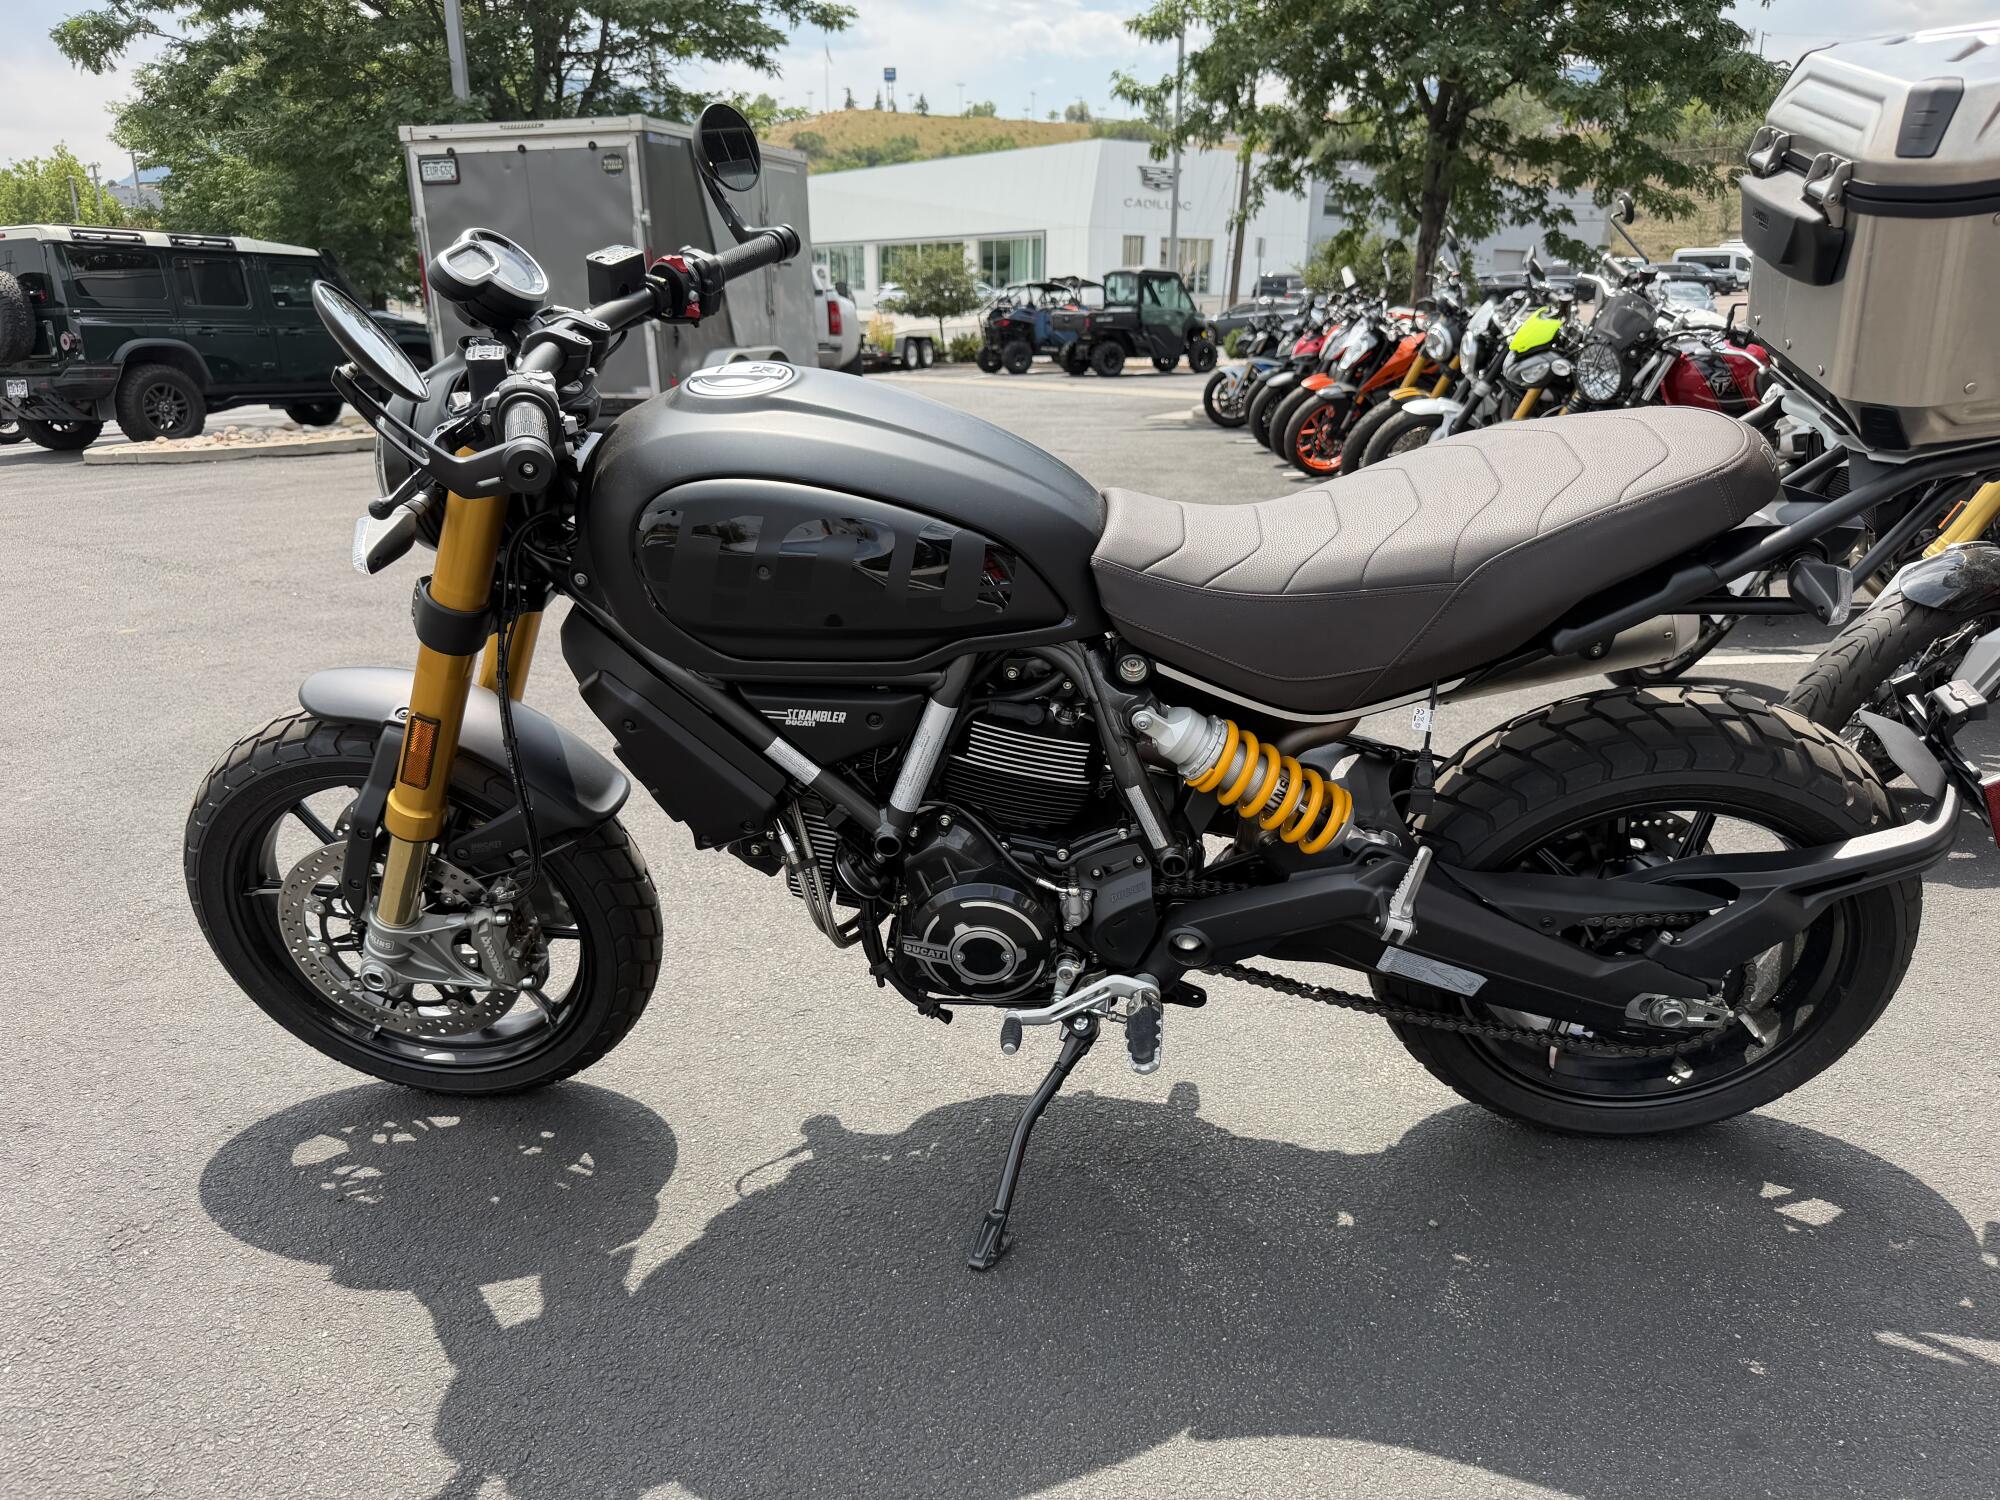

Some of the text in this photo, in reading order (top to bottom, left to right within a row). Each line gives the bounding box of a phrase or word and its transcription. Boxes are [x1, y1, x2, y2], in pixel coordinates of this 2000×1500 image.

[785, 719, 816, 727] DUCATI
[787, 709, 847, 724] SCRAMBLER
[903, 942, 948, 961] DUCATI
